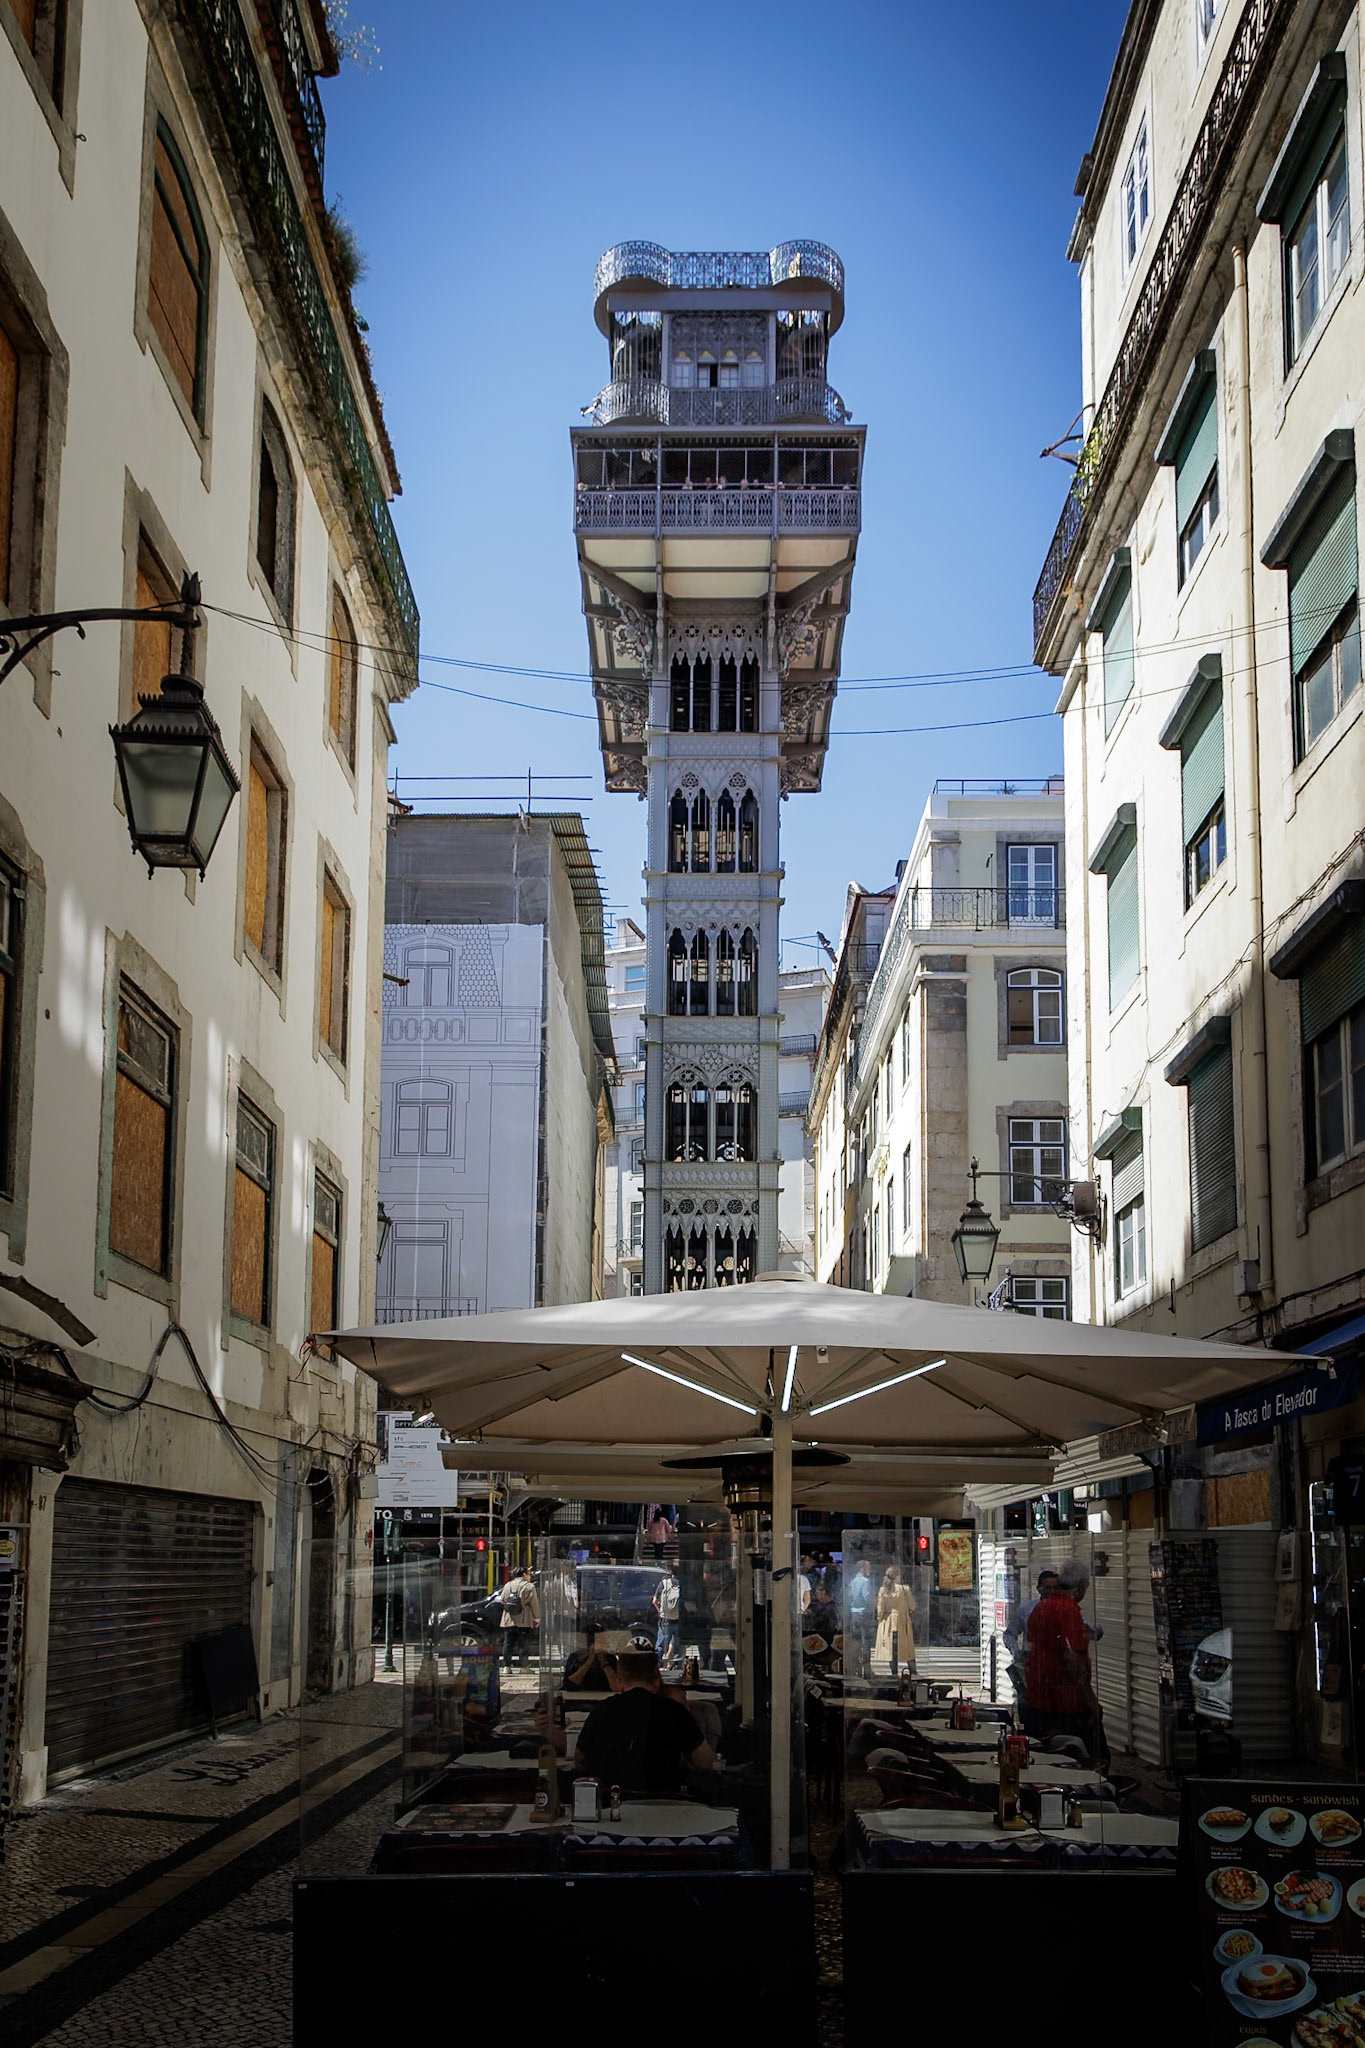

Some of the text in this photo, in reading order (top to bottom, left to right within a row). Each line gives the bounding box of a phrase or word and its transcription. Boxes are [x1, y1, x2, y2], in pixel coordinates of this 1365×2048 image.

[1225, 1385, 1318, 1432] A Tasca do Elevador
